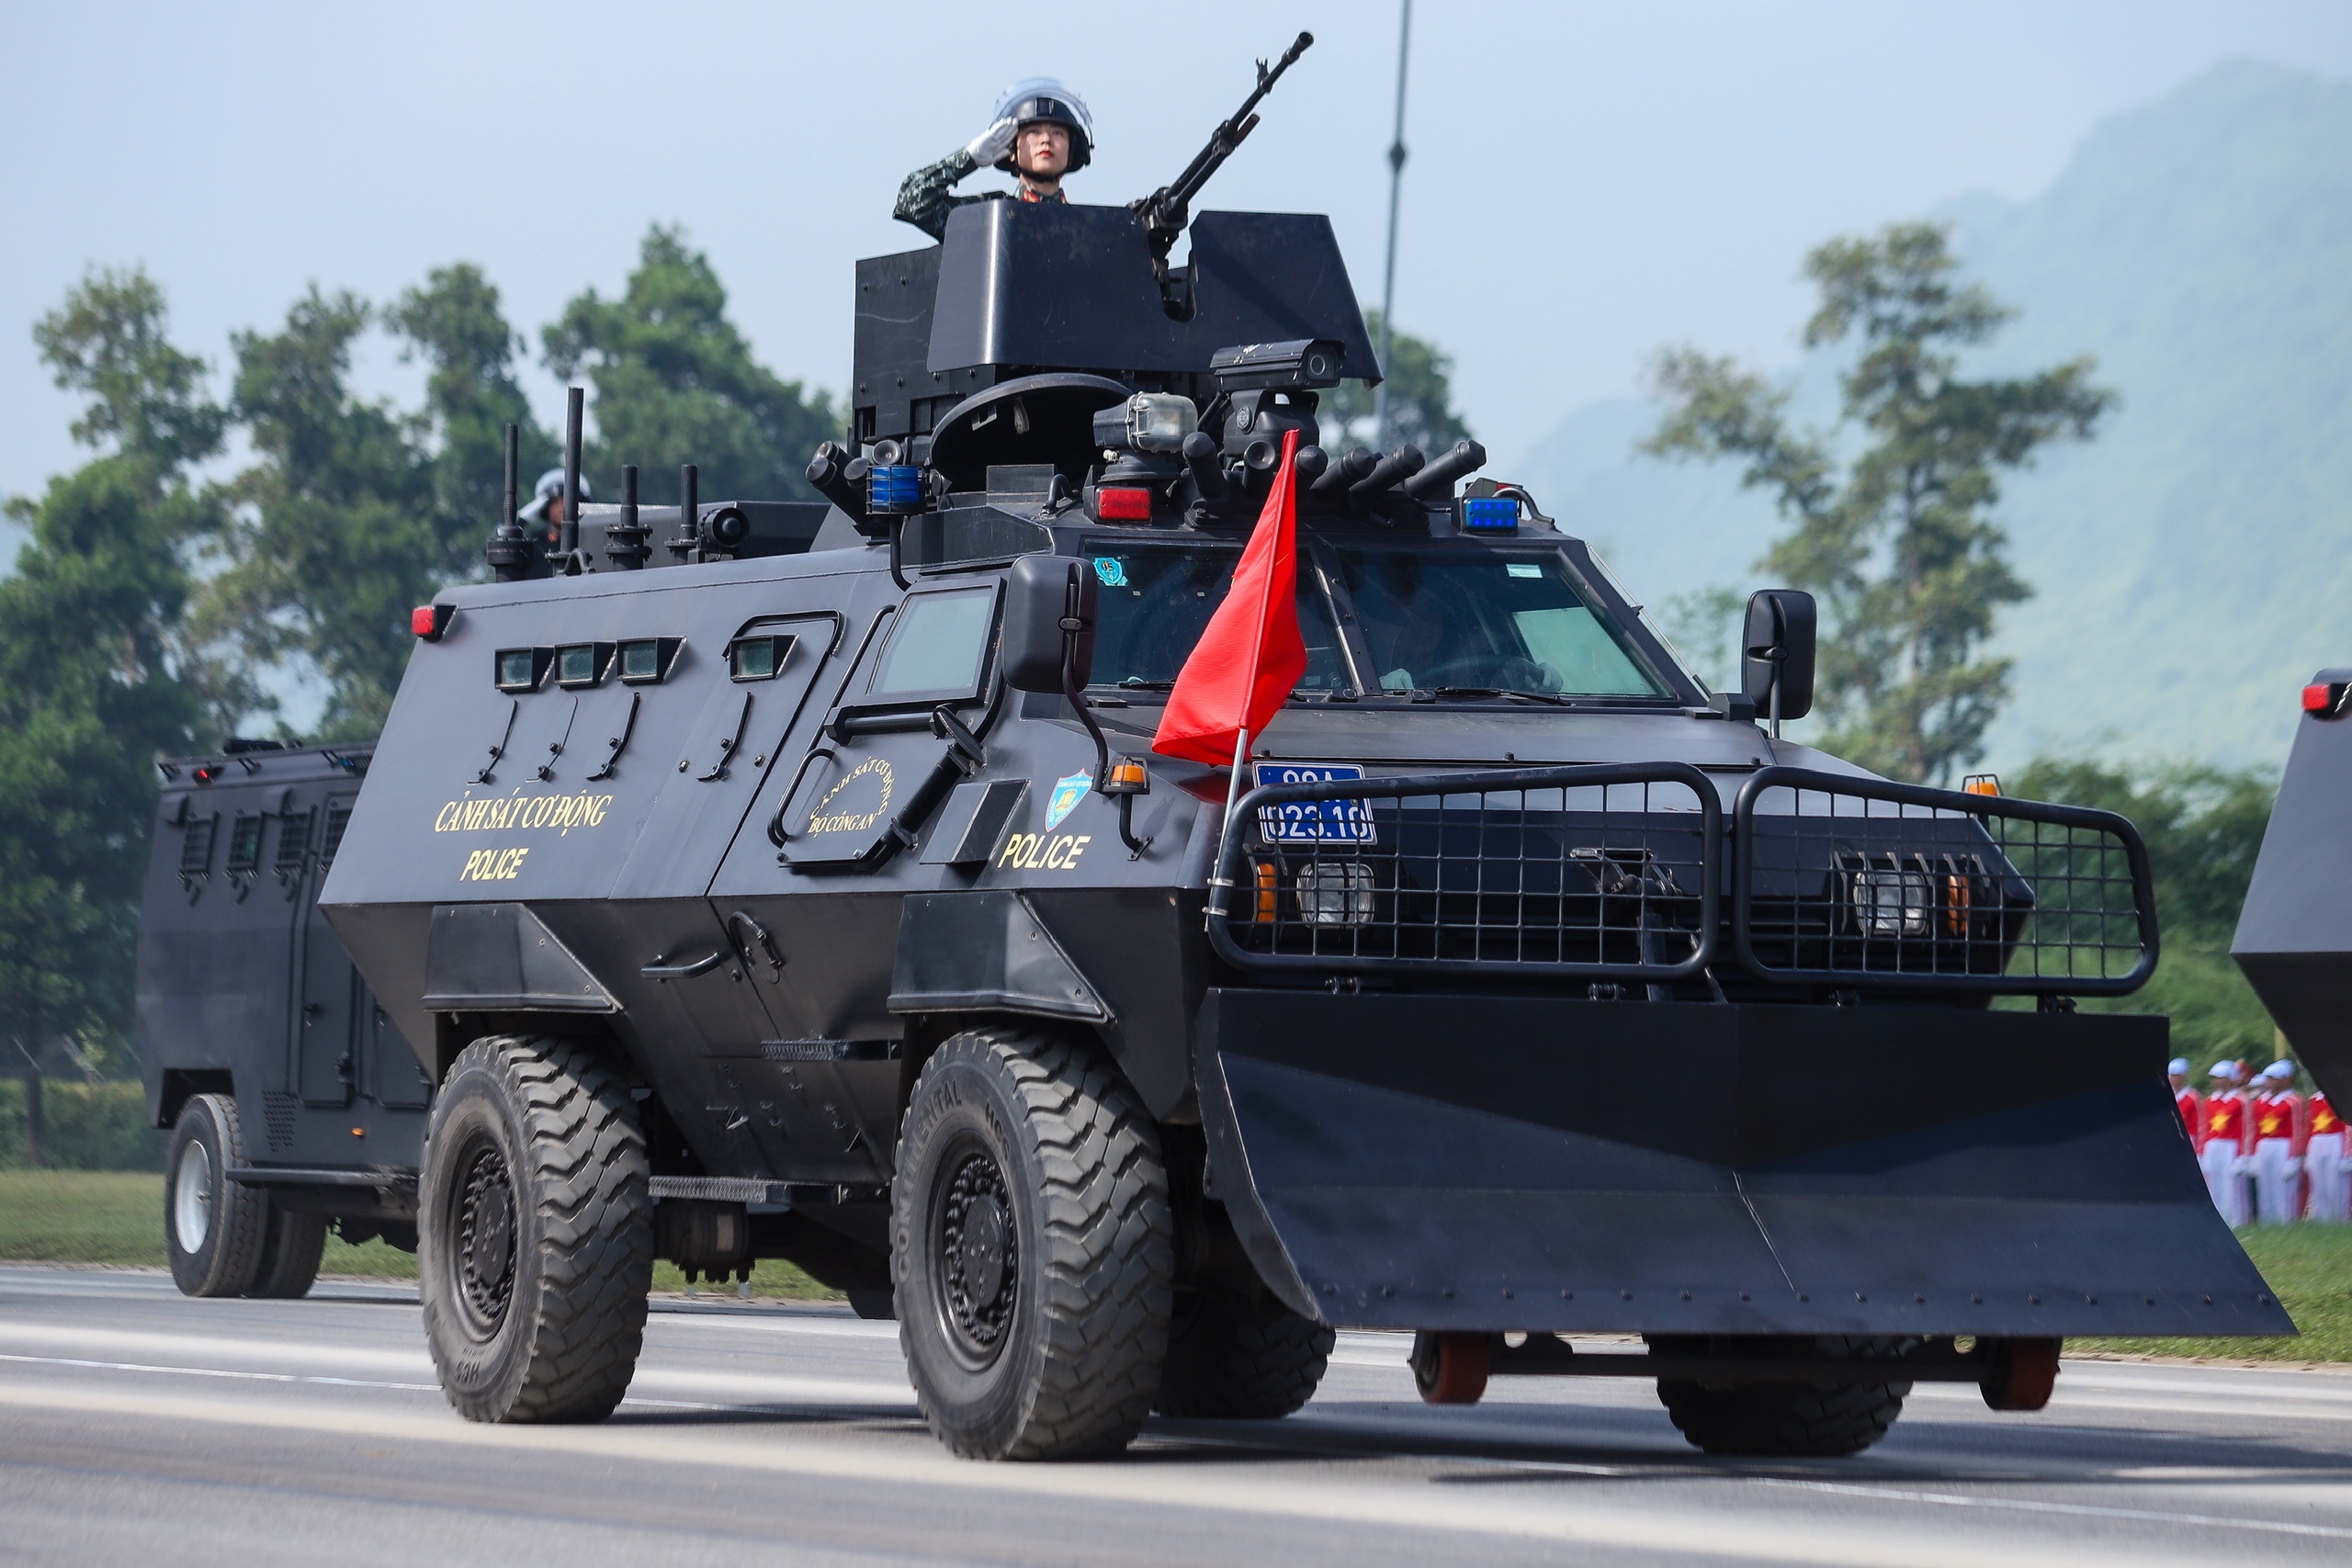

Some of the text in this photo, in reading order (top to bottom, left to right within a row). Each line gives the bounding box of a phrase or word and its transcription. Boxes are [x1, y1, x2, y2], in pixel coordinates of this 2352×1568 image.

[852, 756, 877, 779] SÁT
[435, 787, 615, 837] CẢNH SÁT CƠ ĐỘNG
[807, 809, 877, 838] BỘ CÔNG AN
[1267, 806, 1368, 837] 023.10
[459, 848, 529, 882] POLICE
[997, 833, 1092, 870] POLICE
[897, 1080, 962, 1282] CONTINENTAL
